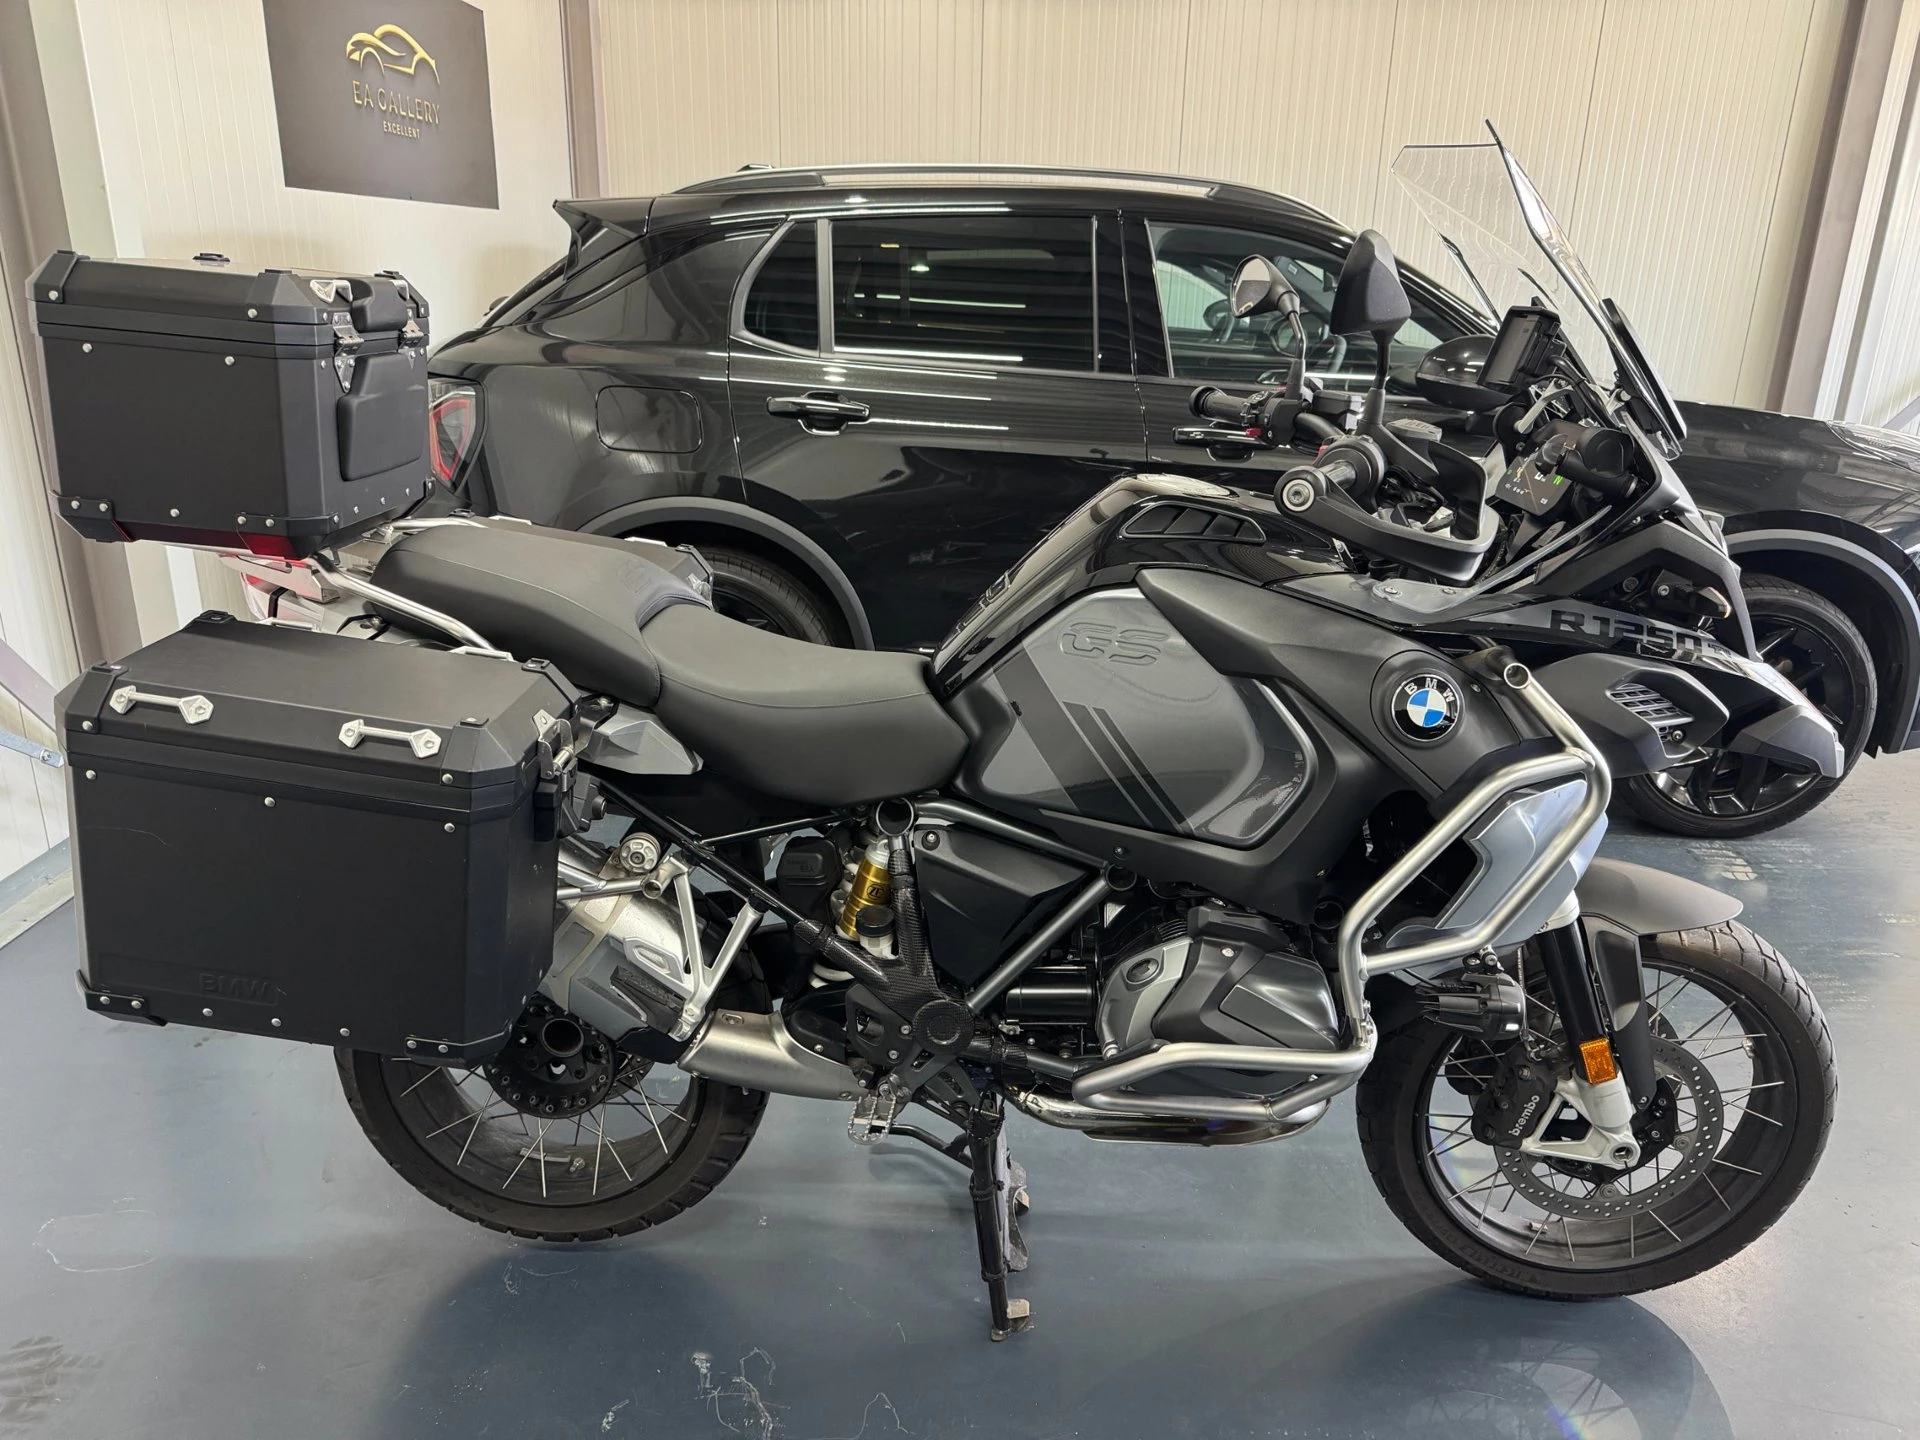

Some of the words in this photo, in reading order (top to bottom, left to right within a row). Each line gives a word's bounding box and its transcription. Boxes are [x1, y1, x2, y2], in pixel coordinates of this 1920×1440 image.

[352, 80, 374, 108] EA
[378, 87, 441, 125] GALLERY
[383, 120, 420, 139] EXCELLENT
[1059, 621, 1170, 666] GS
[1404, 677, 1456, 703] BMW
[199, 972, 270, 999] BMW
[1508, 1095, 1540, 1136] brembo
